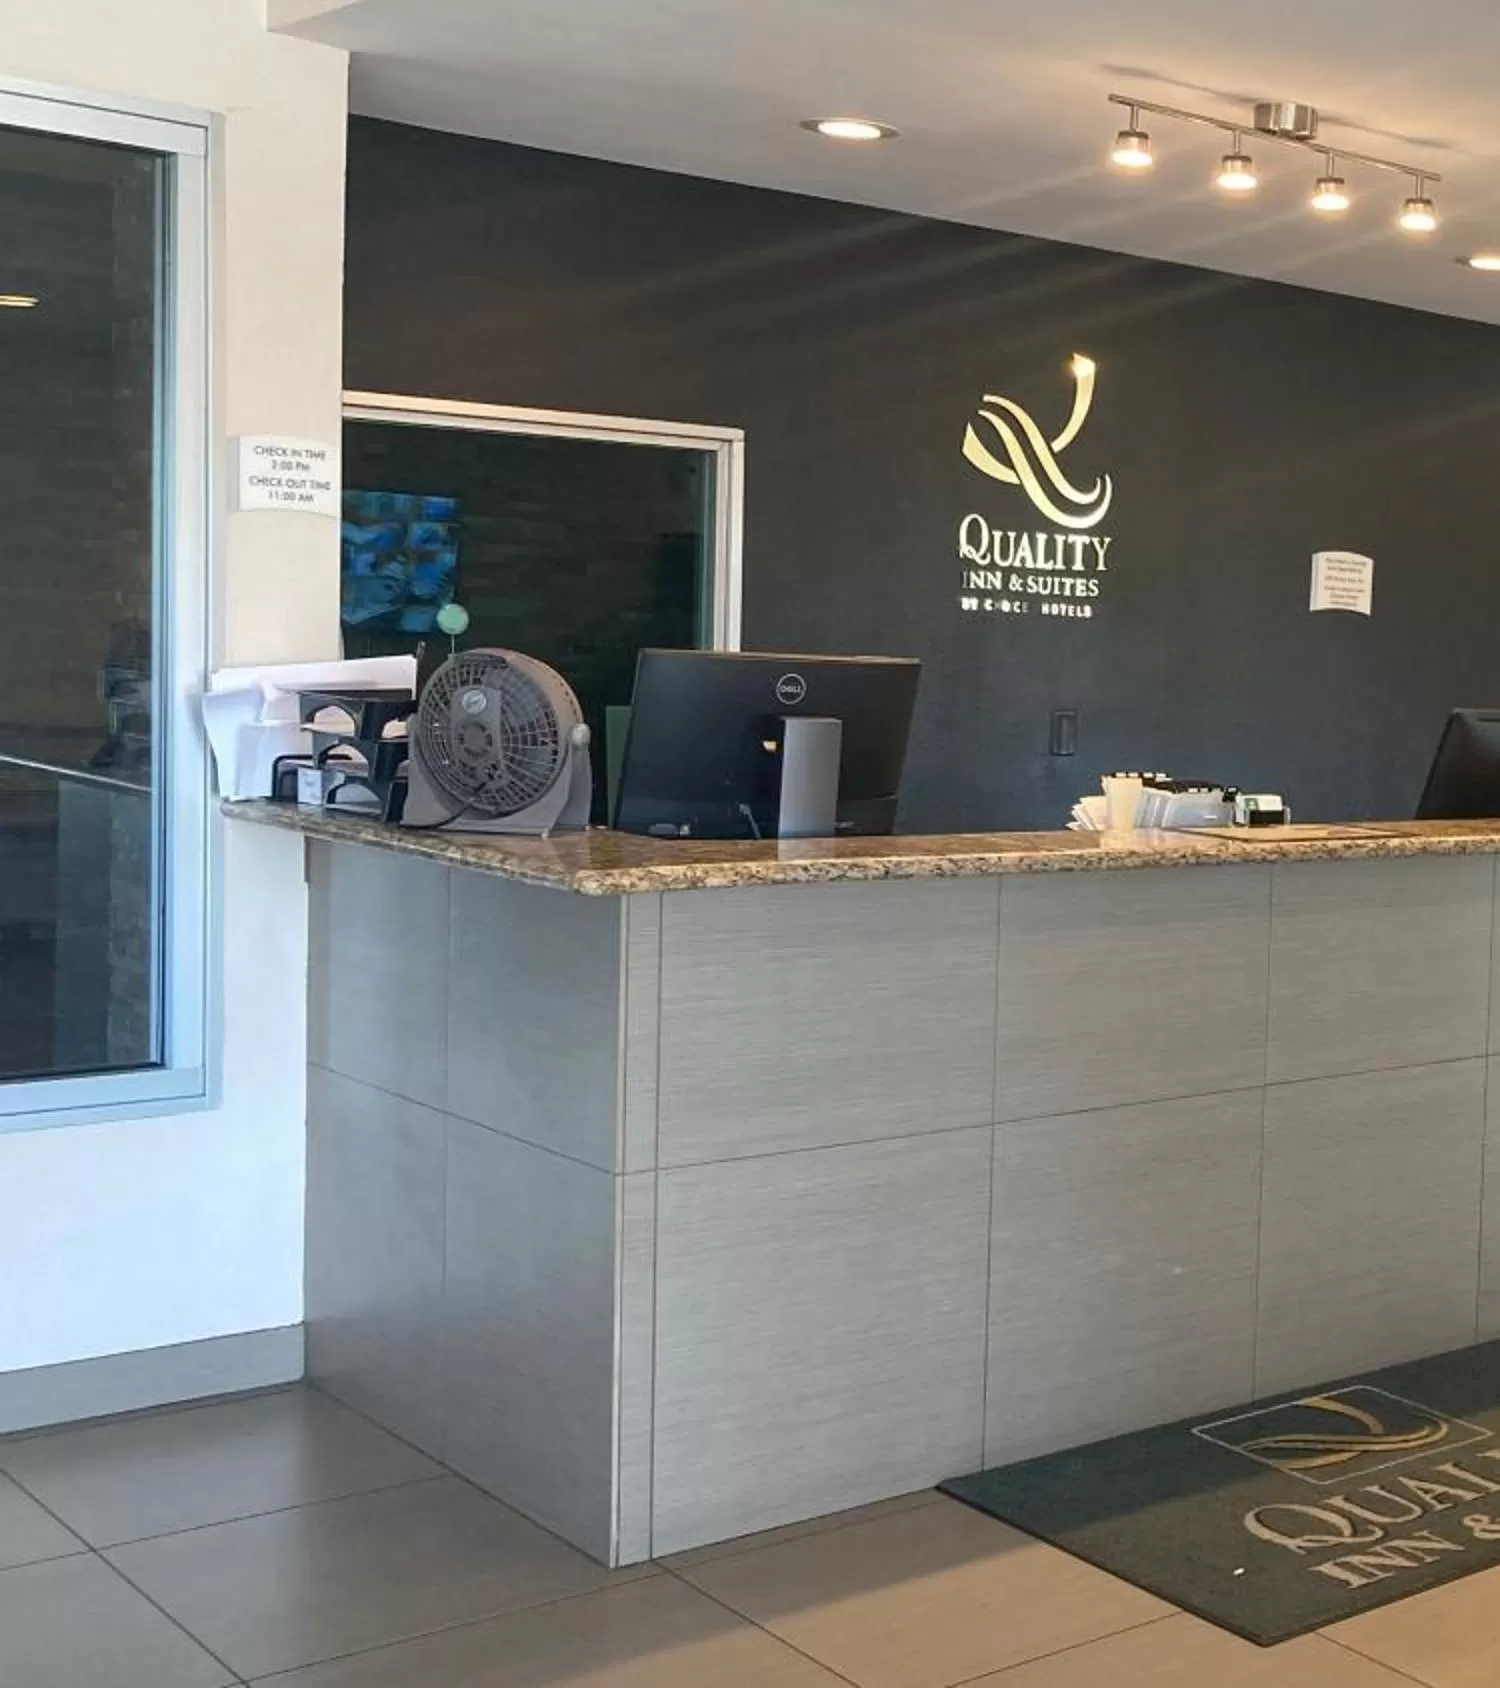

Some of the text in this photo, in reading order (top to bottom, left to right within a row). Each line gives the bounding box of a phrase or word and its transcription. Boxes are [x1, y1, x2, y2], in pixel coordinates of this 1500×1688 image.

[253, 445, 326, 461] CHECK IN TIME
[248, 475, 332, 491] CHECK OUT TIME
[298, 493, 315, 503] AM
[959, 513, 1112, 571] QUALITY
[962, 571, 1101, 597] INN & SUITES
[983, 598, 1029, 613] COCE
[1041, 603, 1093, 618] HOTELS
[1310, 1529, 1465, 1590] INN
